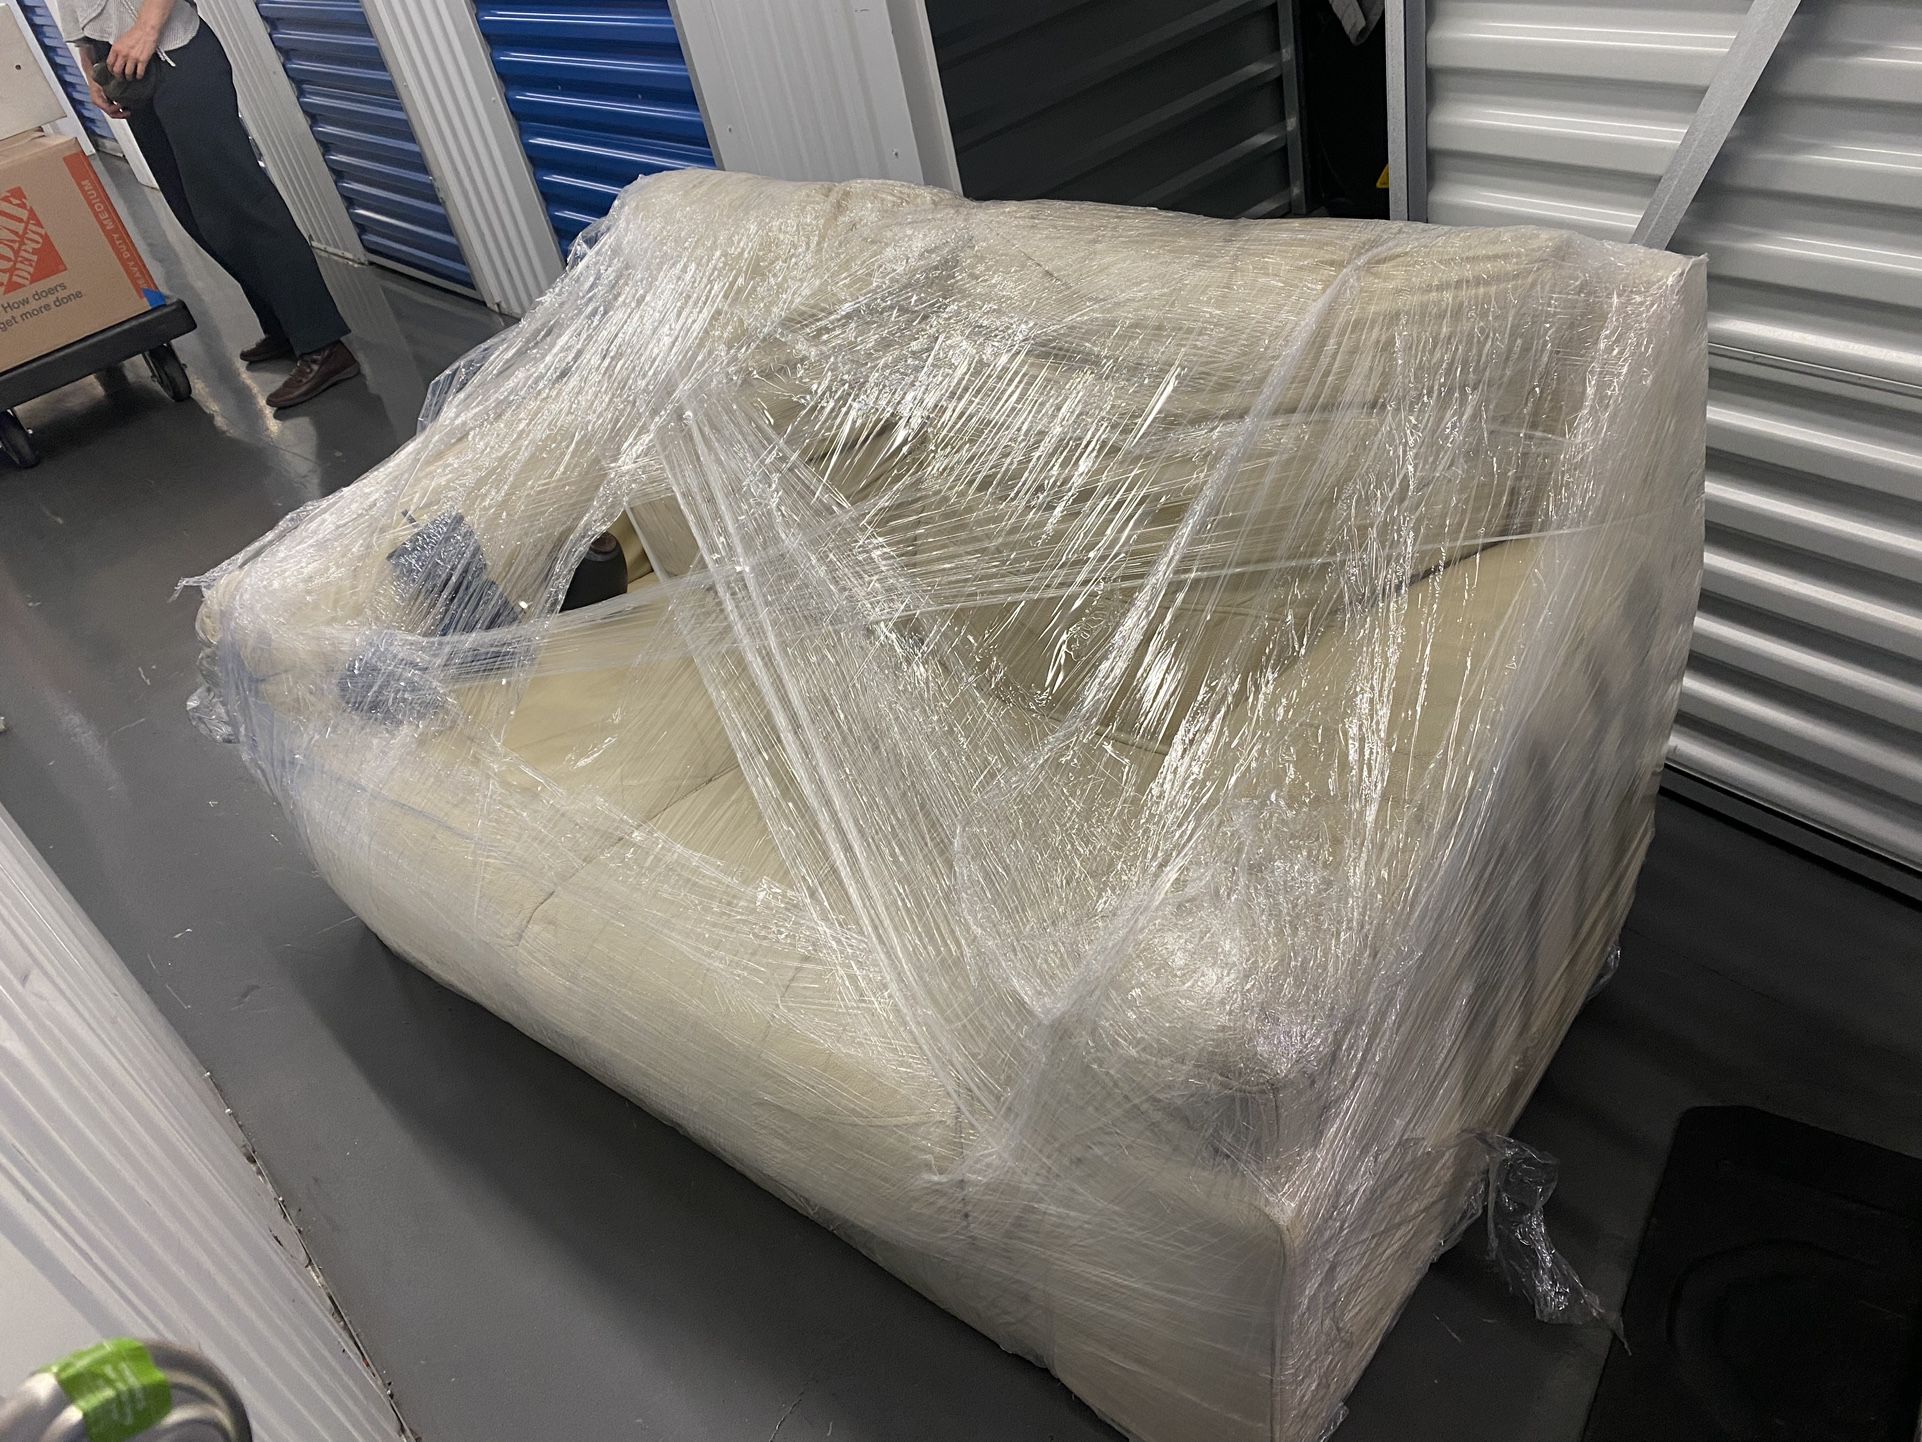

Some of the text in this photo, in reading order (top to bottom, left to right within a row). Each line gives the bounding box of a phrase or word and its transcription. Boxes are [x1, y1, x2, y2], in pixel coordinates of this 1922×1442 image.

[81, 179, 115, 230] MEDIUM
[0, 190, 30, 287] OME
[11, 220, 46, 285] DEPOT
[112, 233, 131, 259] DUTY
[0, 290, 83, 332] get more done
[1, 282, 67, 314] How doers
